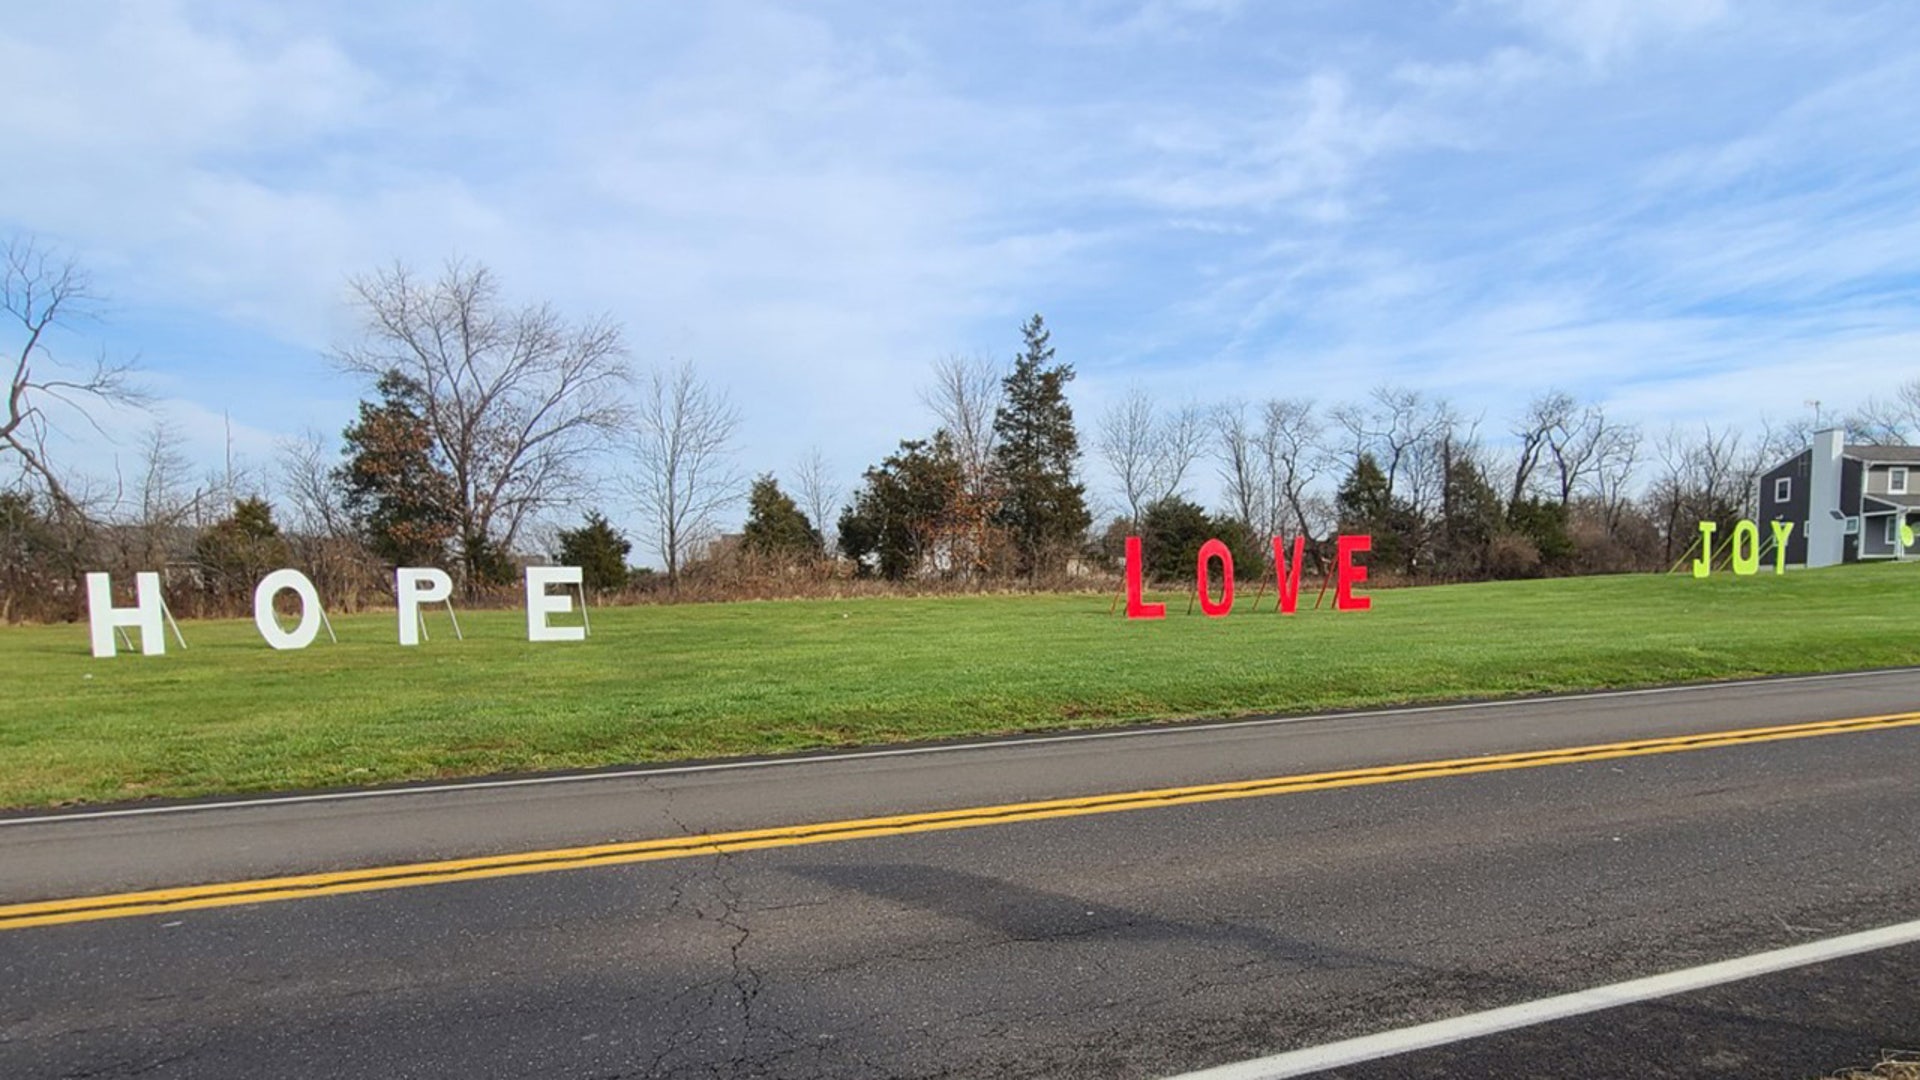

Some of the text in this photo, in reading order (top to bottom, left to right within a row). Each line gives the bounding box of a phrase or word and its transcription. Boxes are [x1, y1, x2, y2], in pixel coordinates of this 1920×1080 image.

[1125, 535, 1372, 619] LOVE
[1693, 520, 1794, 578] JOY
[86, 566, 585, 657] HOPE
